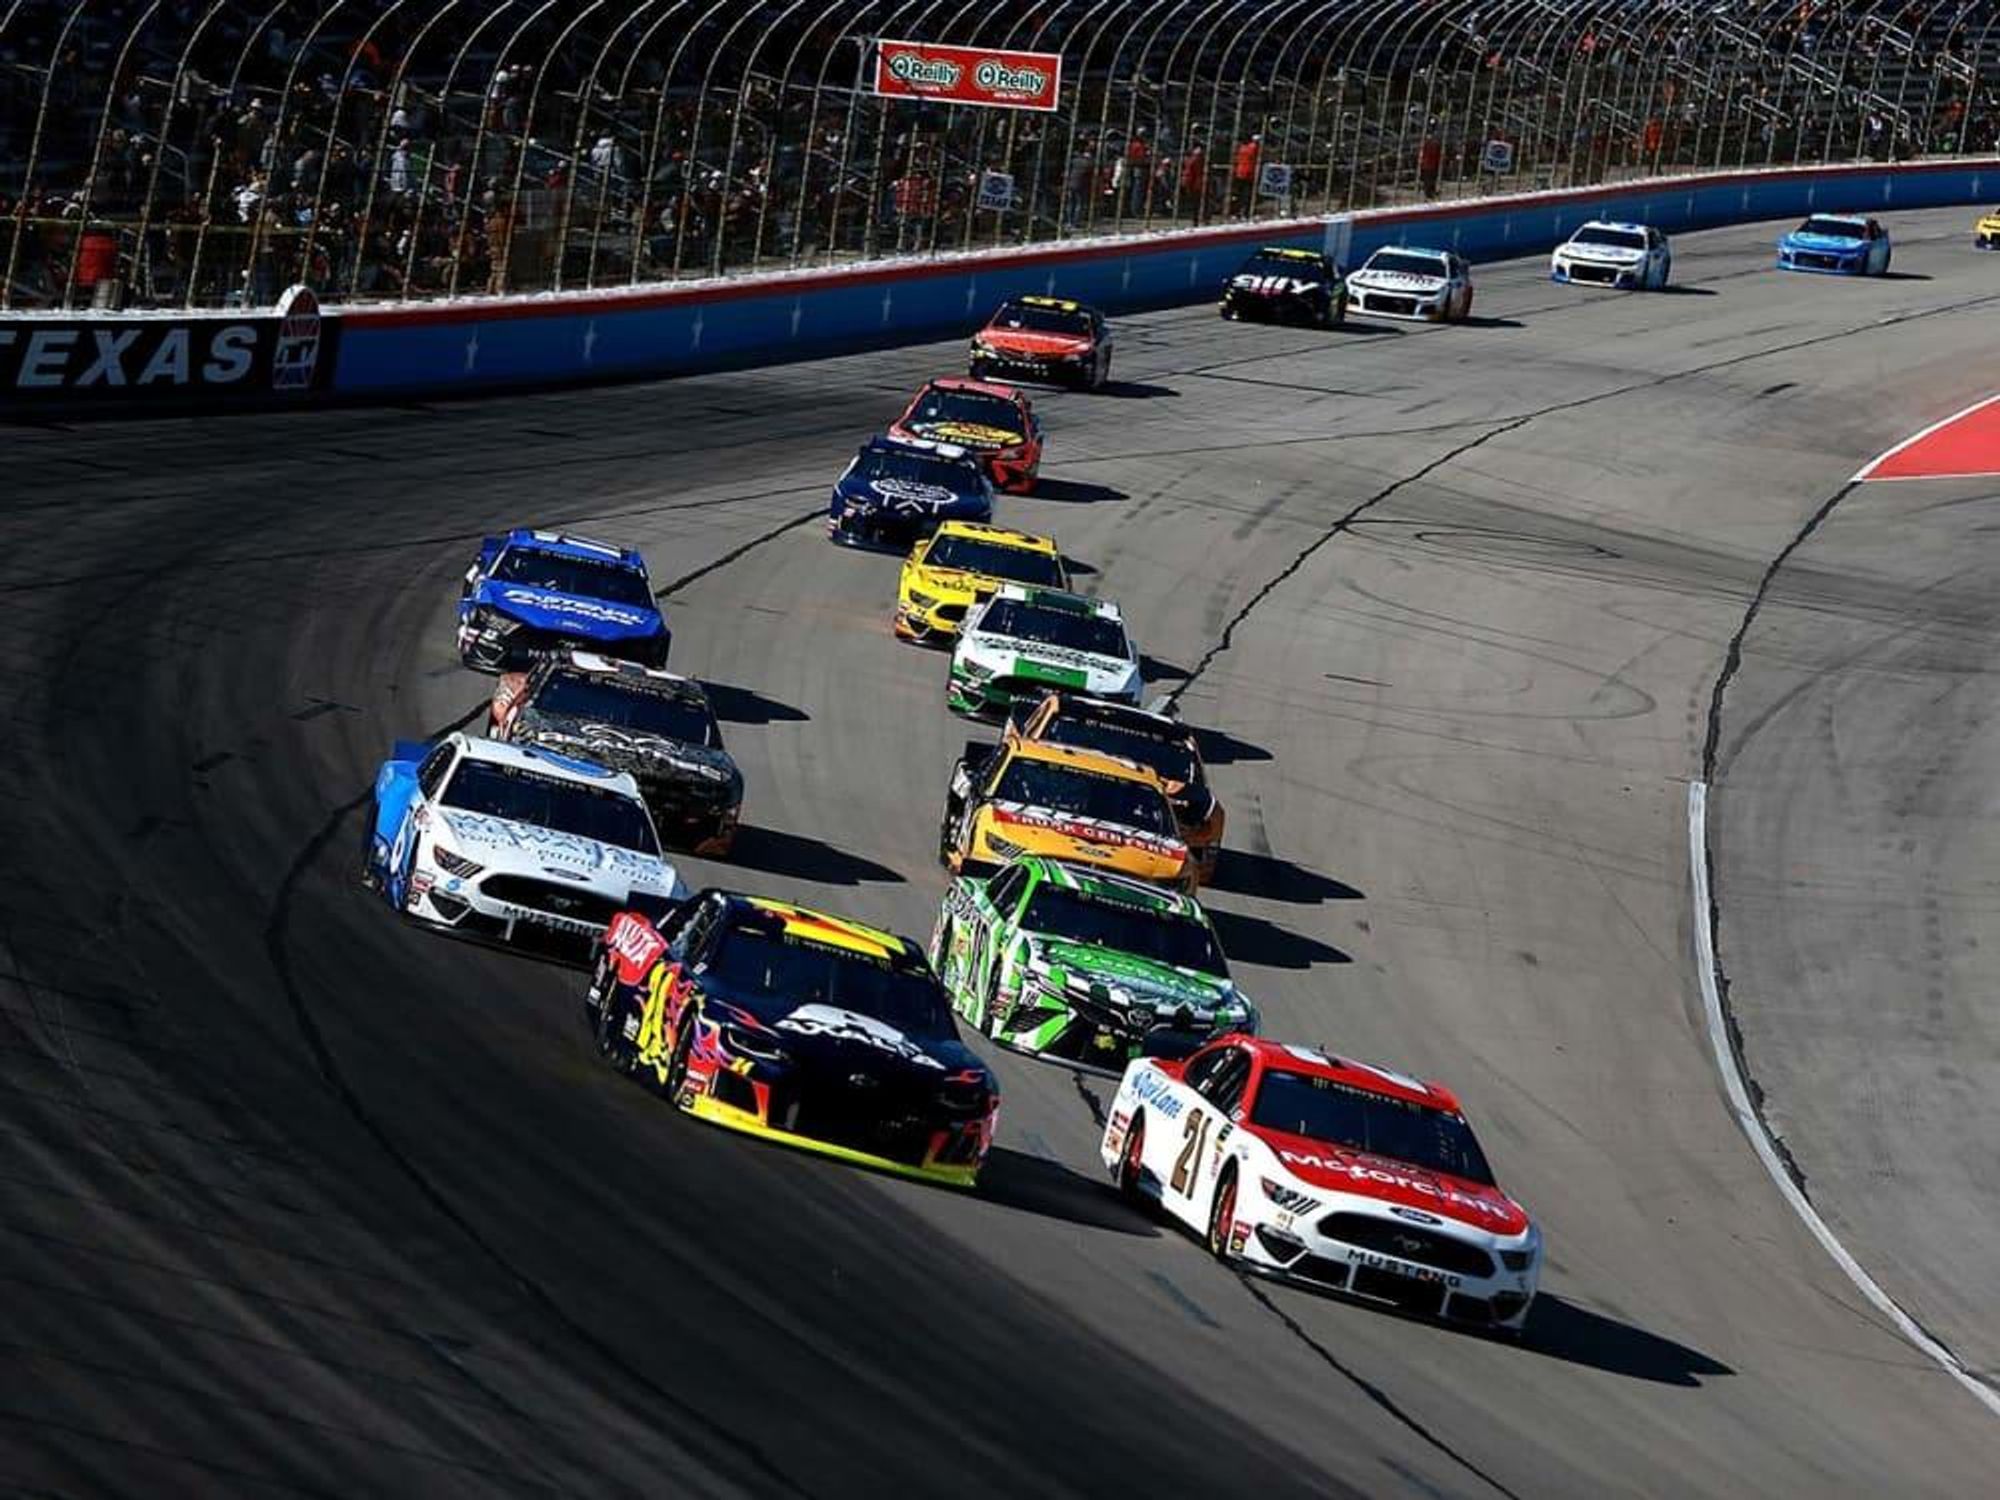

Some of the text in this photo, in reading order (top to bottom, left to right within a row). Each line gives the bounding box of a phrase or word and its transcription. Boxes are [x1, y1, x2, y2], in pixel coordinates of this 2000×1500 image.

[890, 54, 960, 87] O'Reilly
[978, 63, 1045, 94] O'Reilly
[1232, 273, 1321, 294] ally
[0, 326, 258, 386] EXAS
[1170, 1107, 1213, 1201] 21
[1347, 1249, 1462, 1288] MUSTANG
